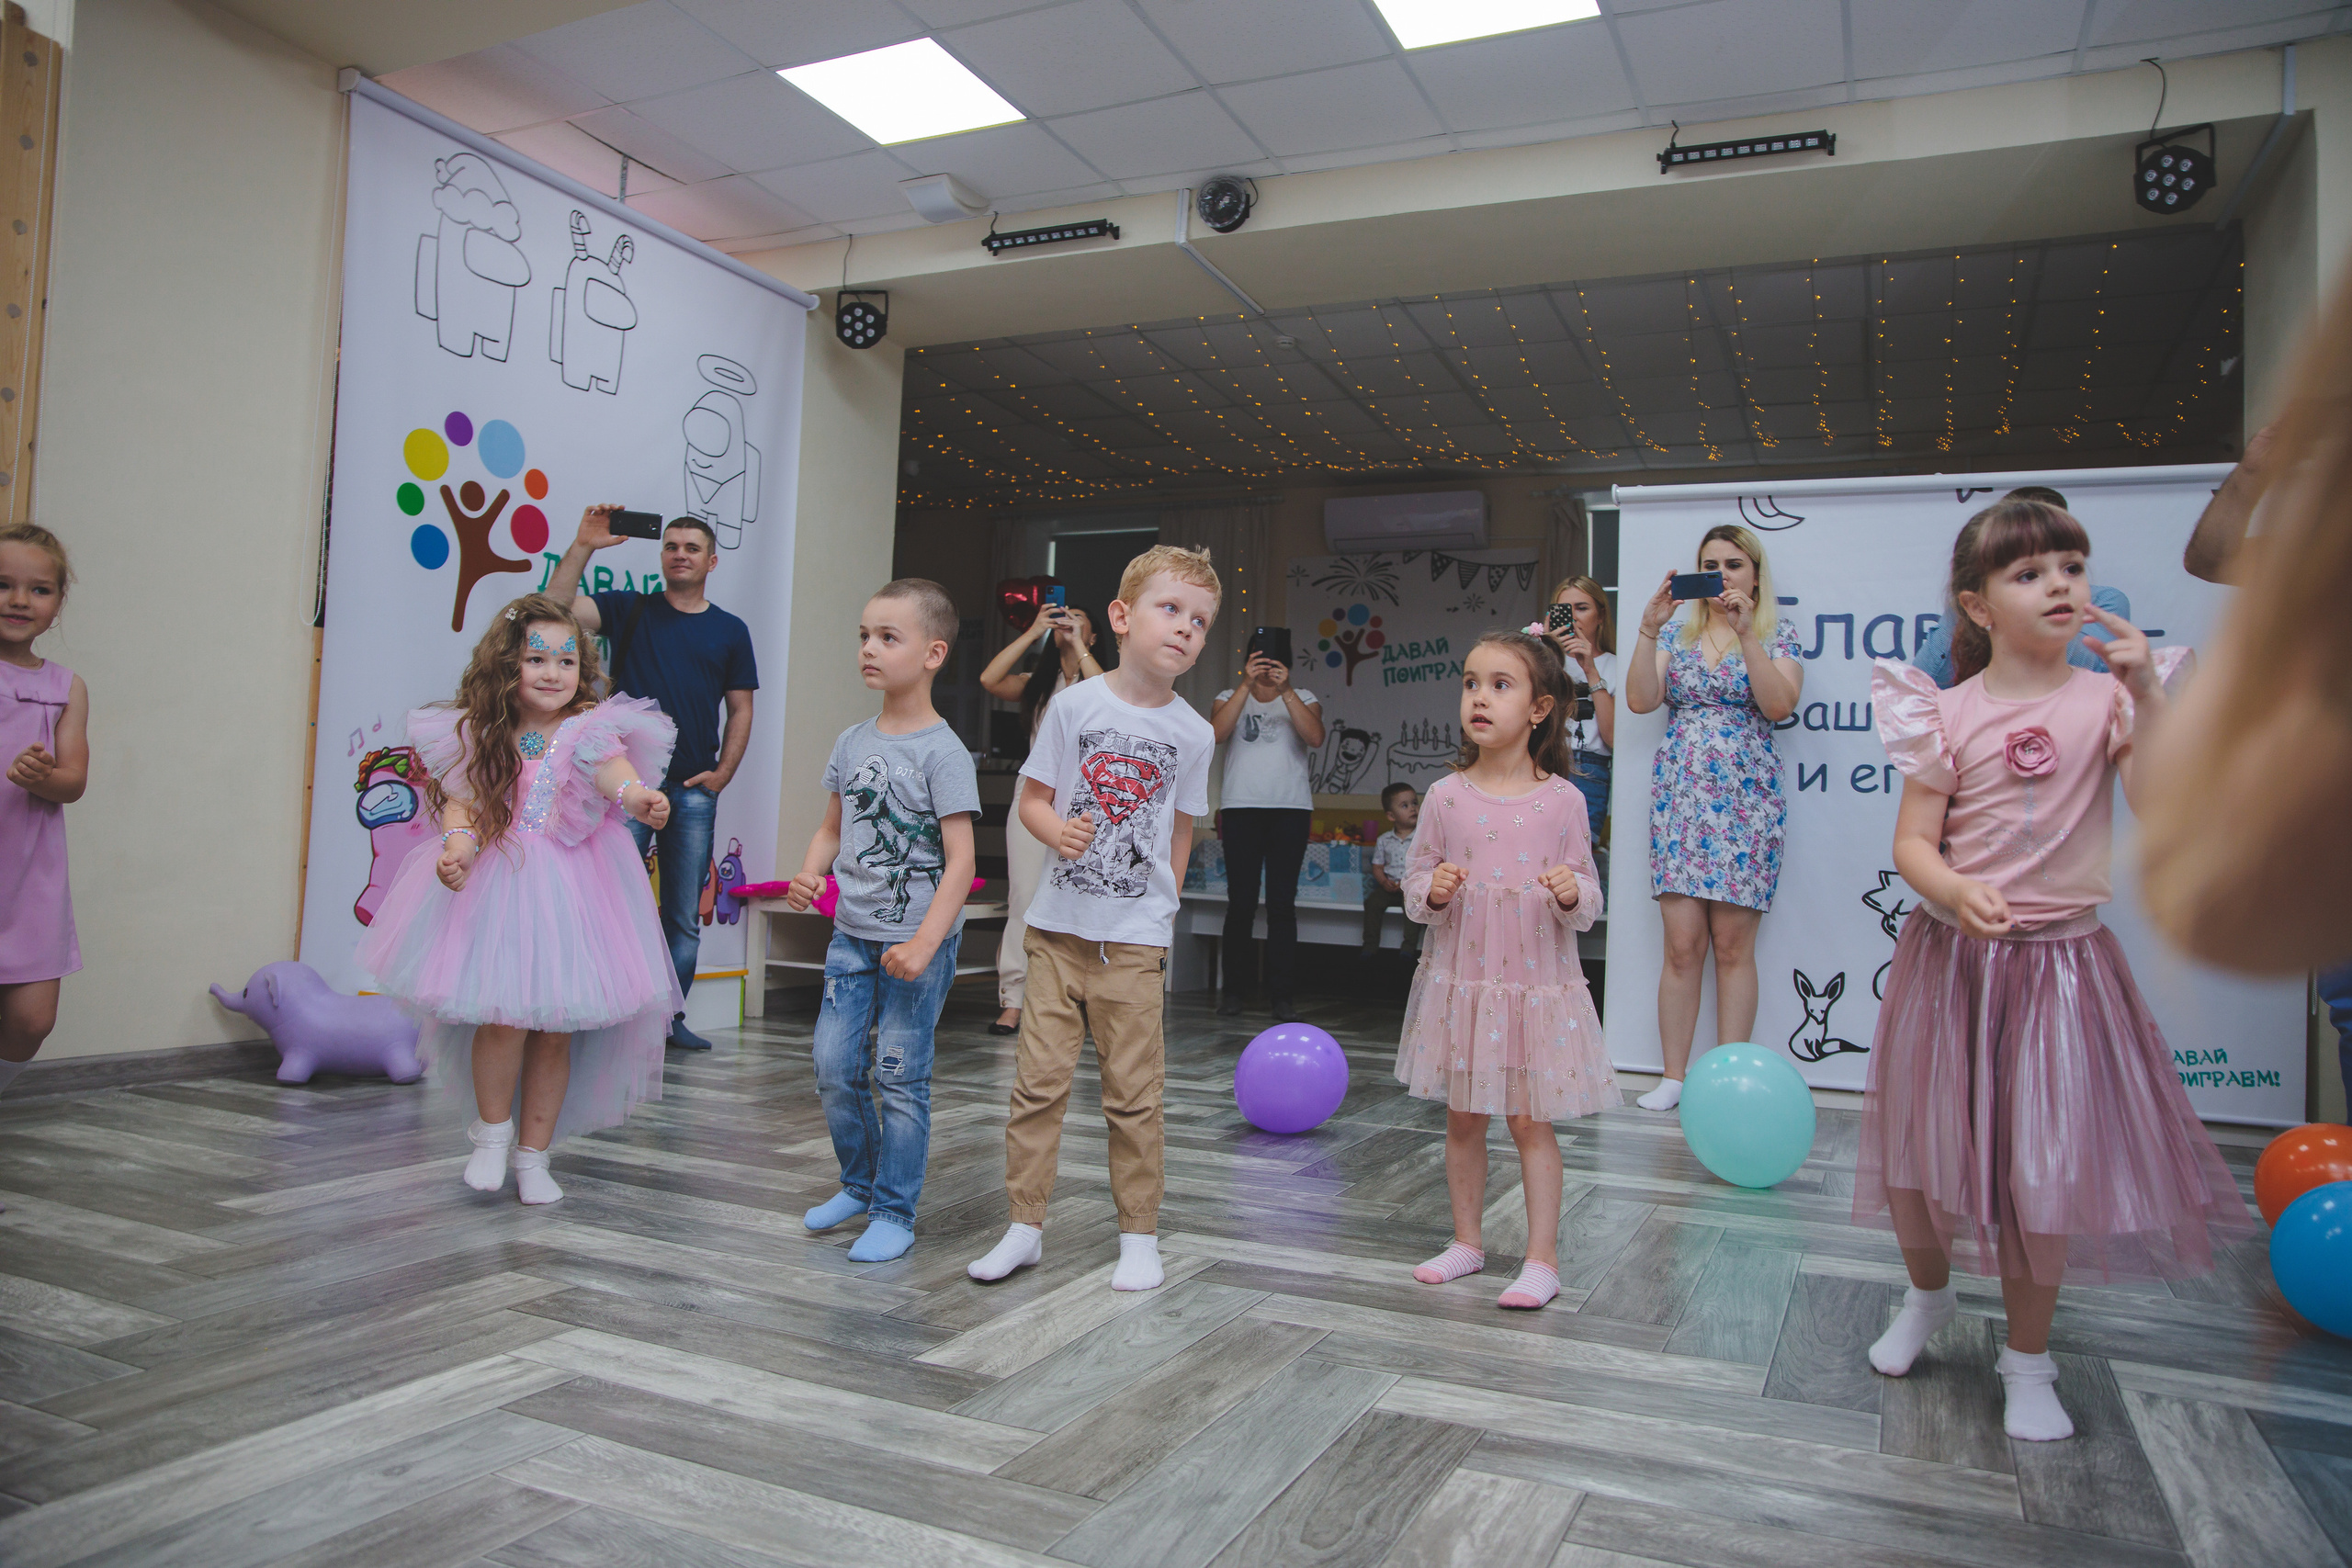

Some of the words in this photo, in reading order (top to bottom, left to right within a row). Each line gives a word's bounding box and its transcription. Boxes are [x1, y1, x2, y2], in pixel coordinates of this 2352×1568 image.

[1382, 637, 1449, 664] ДАВАЙ
[1383, 660, 1465, 687] ПОИГРА
[1773, 701, 1872, 731] аш
[1798, 762, 1827, 793] и
